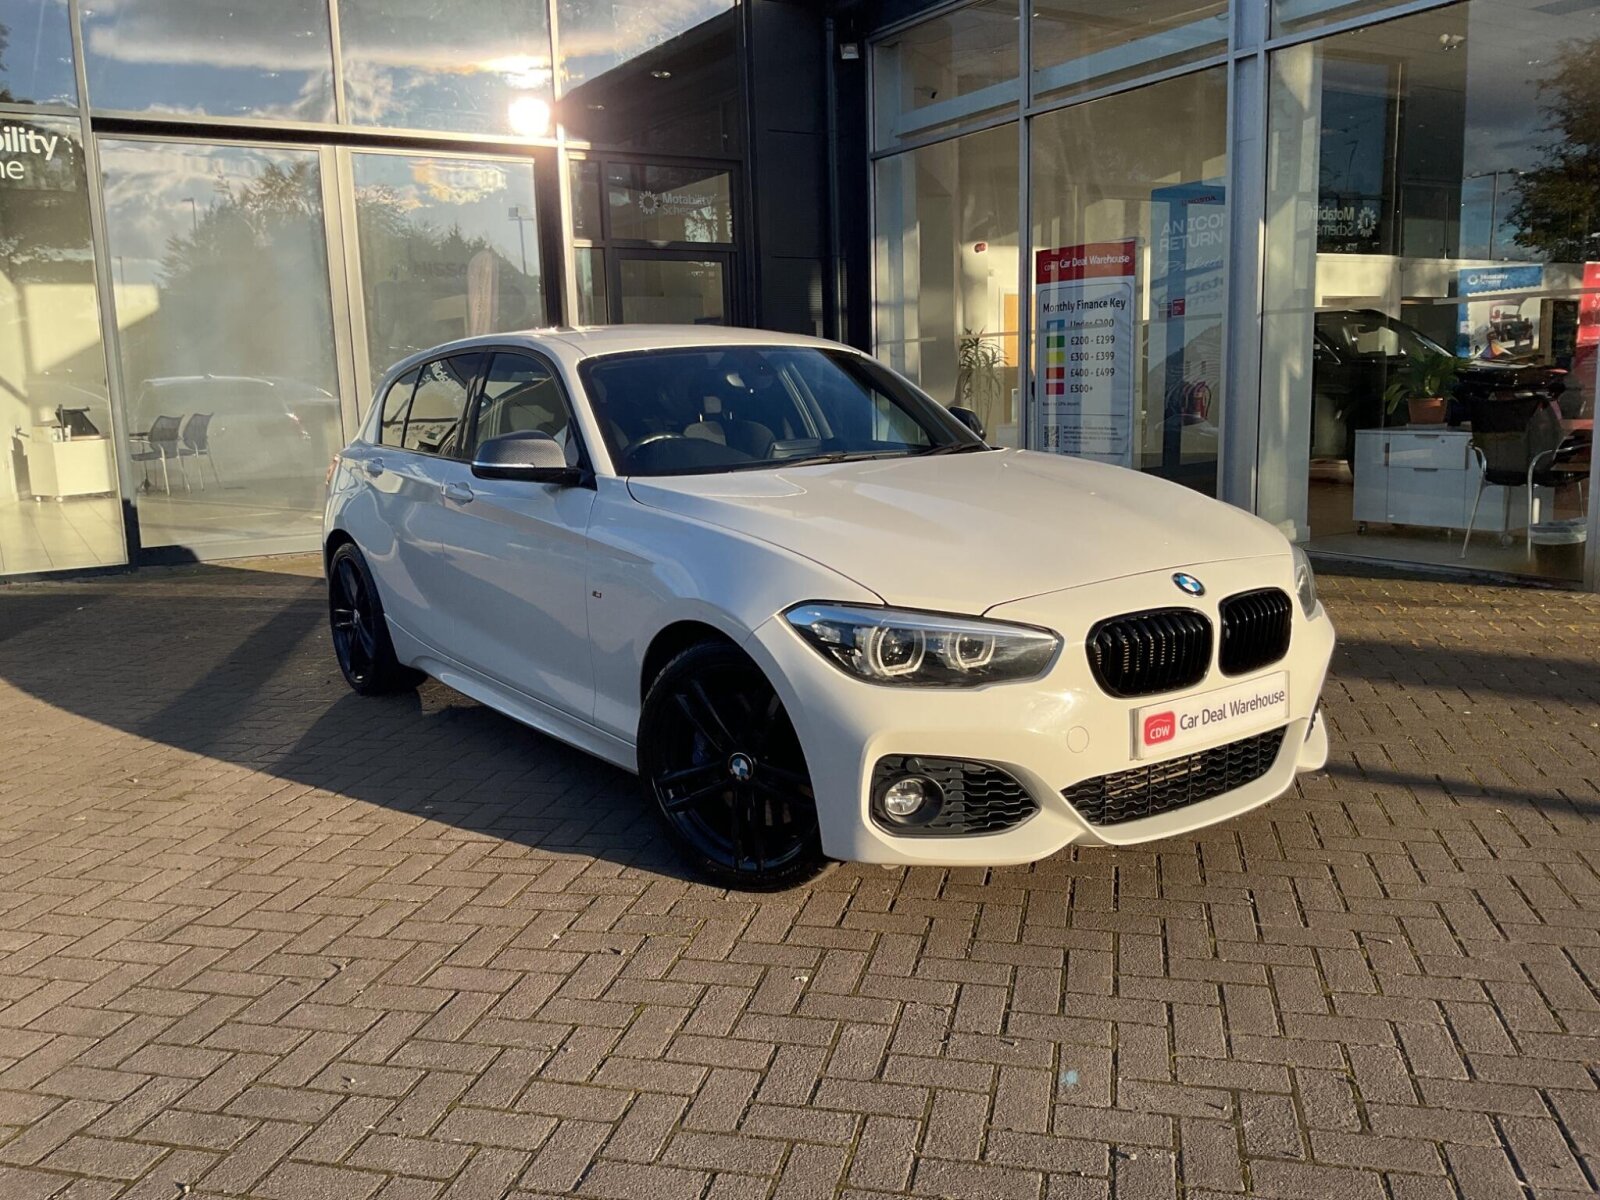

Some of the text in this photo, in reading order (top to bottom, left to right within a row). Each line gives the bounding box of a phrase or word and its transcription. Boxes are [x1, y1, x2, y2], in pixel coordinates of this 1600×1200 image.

[1160, 221, 1184, 237] AN
[1160, 230, 1223, 252] RETURN
[1060, 259, 1072, 268] Car
[1072, 257, 1088, 267] Deal
[1089, 254, 1130, 265] Warehouse
[1043, 298, 1126, 313] Monthly Finance Key
[1070, 336, 1090, 346] £200
[1096, 335, 1115, 345] £299
[1070, 352, 1089, 361] £300
[1096, 351, 1115, 361] £399
[1070, 368, 1089, 377] £400
[1096, 368, 1115, 377] £499
[1070, 384, 1093, 393] £500+
[1150, 690, 1285, 740] CDW Car Deal Warehouse
